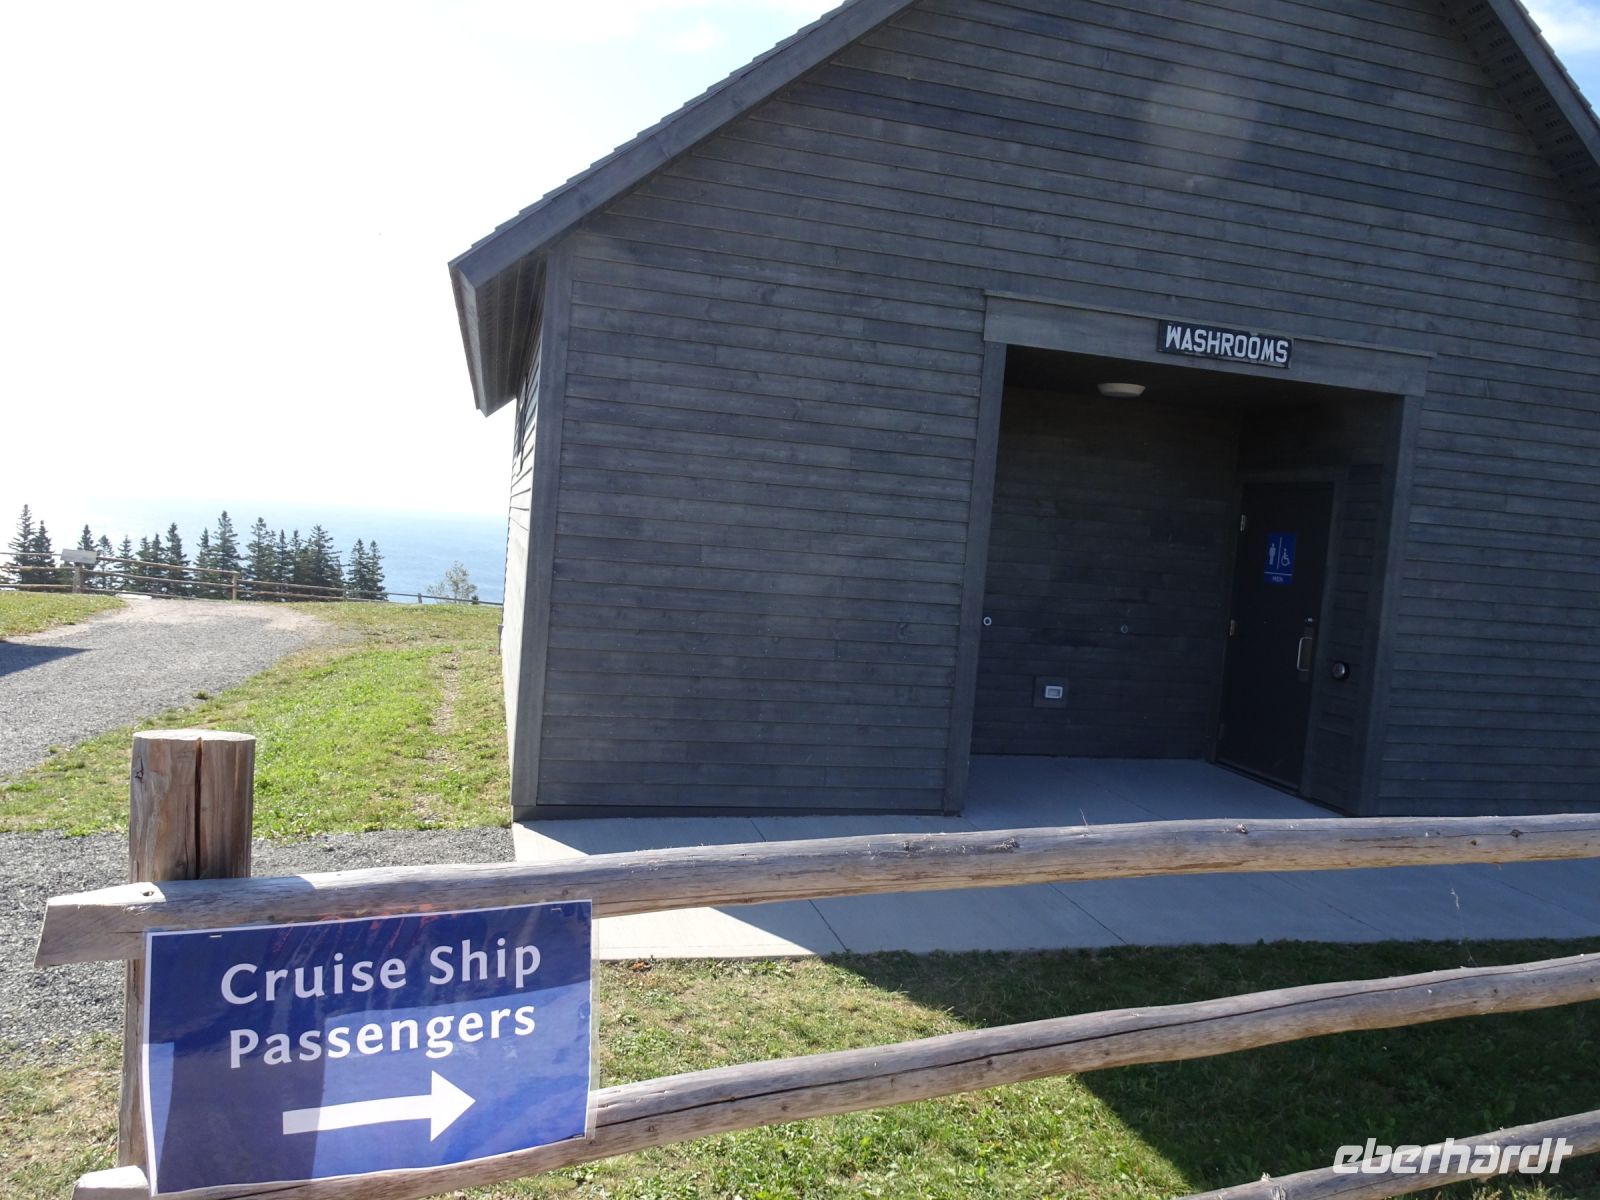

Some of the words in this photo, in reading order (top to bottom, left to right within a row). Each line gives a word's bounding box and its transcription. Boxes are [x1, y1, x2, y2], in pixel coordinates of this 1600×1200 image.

[1165, 325, 1289, 363] WASHROOMS
[221, 953, 406, 1005] Cruise
[429, 938, 541, 988] Ship
[229, 1005, 536, 1069] Passengers
